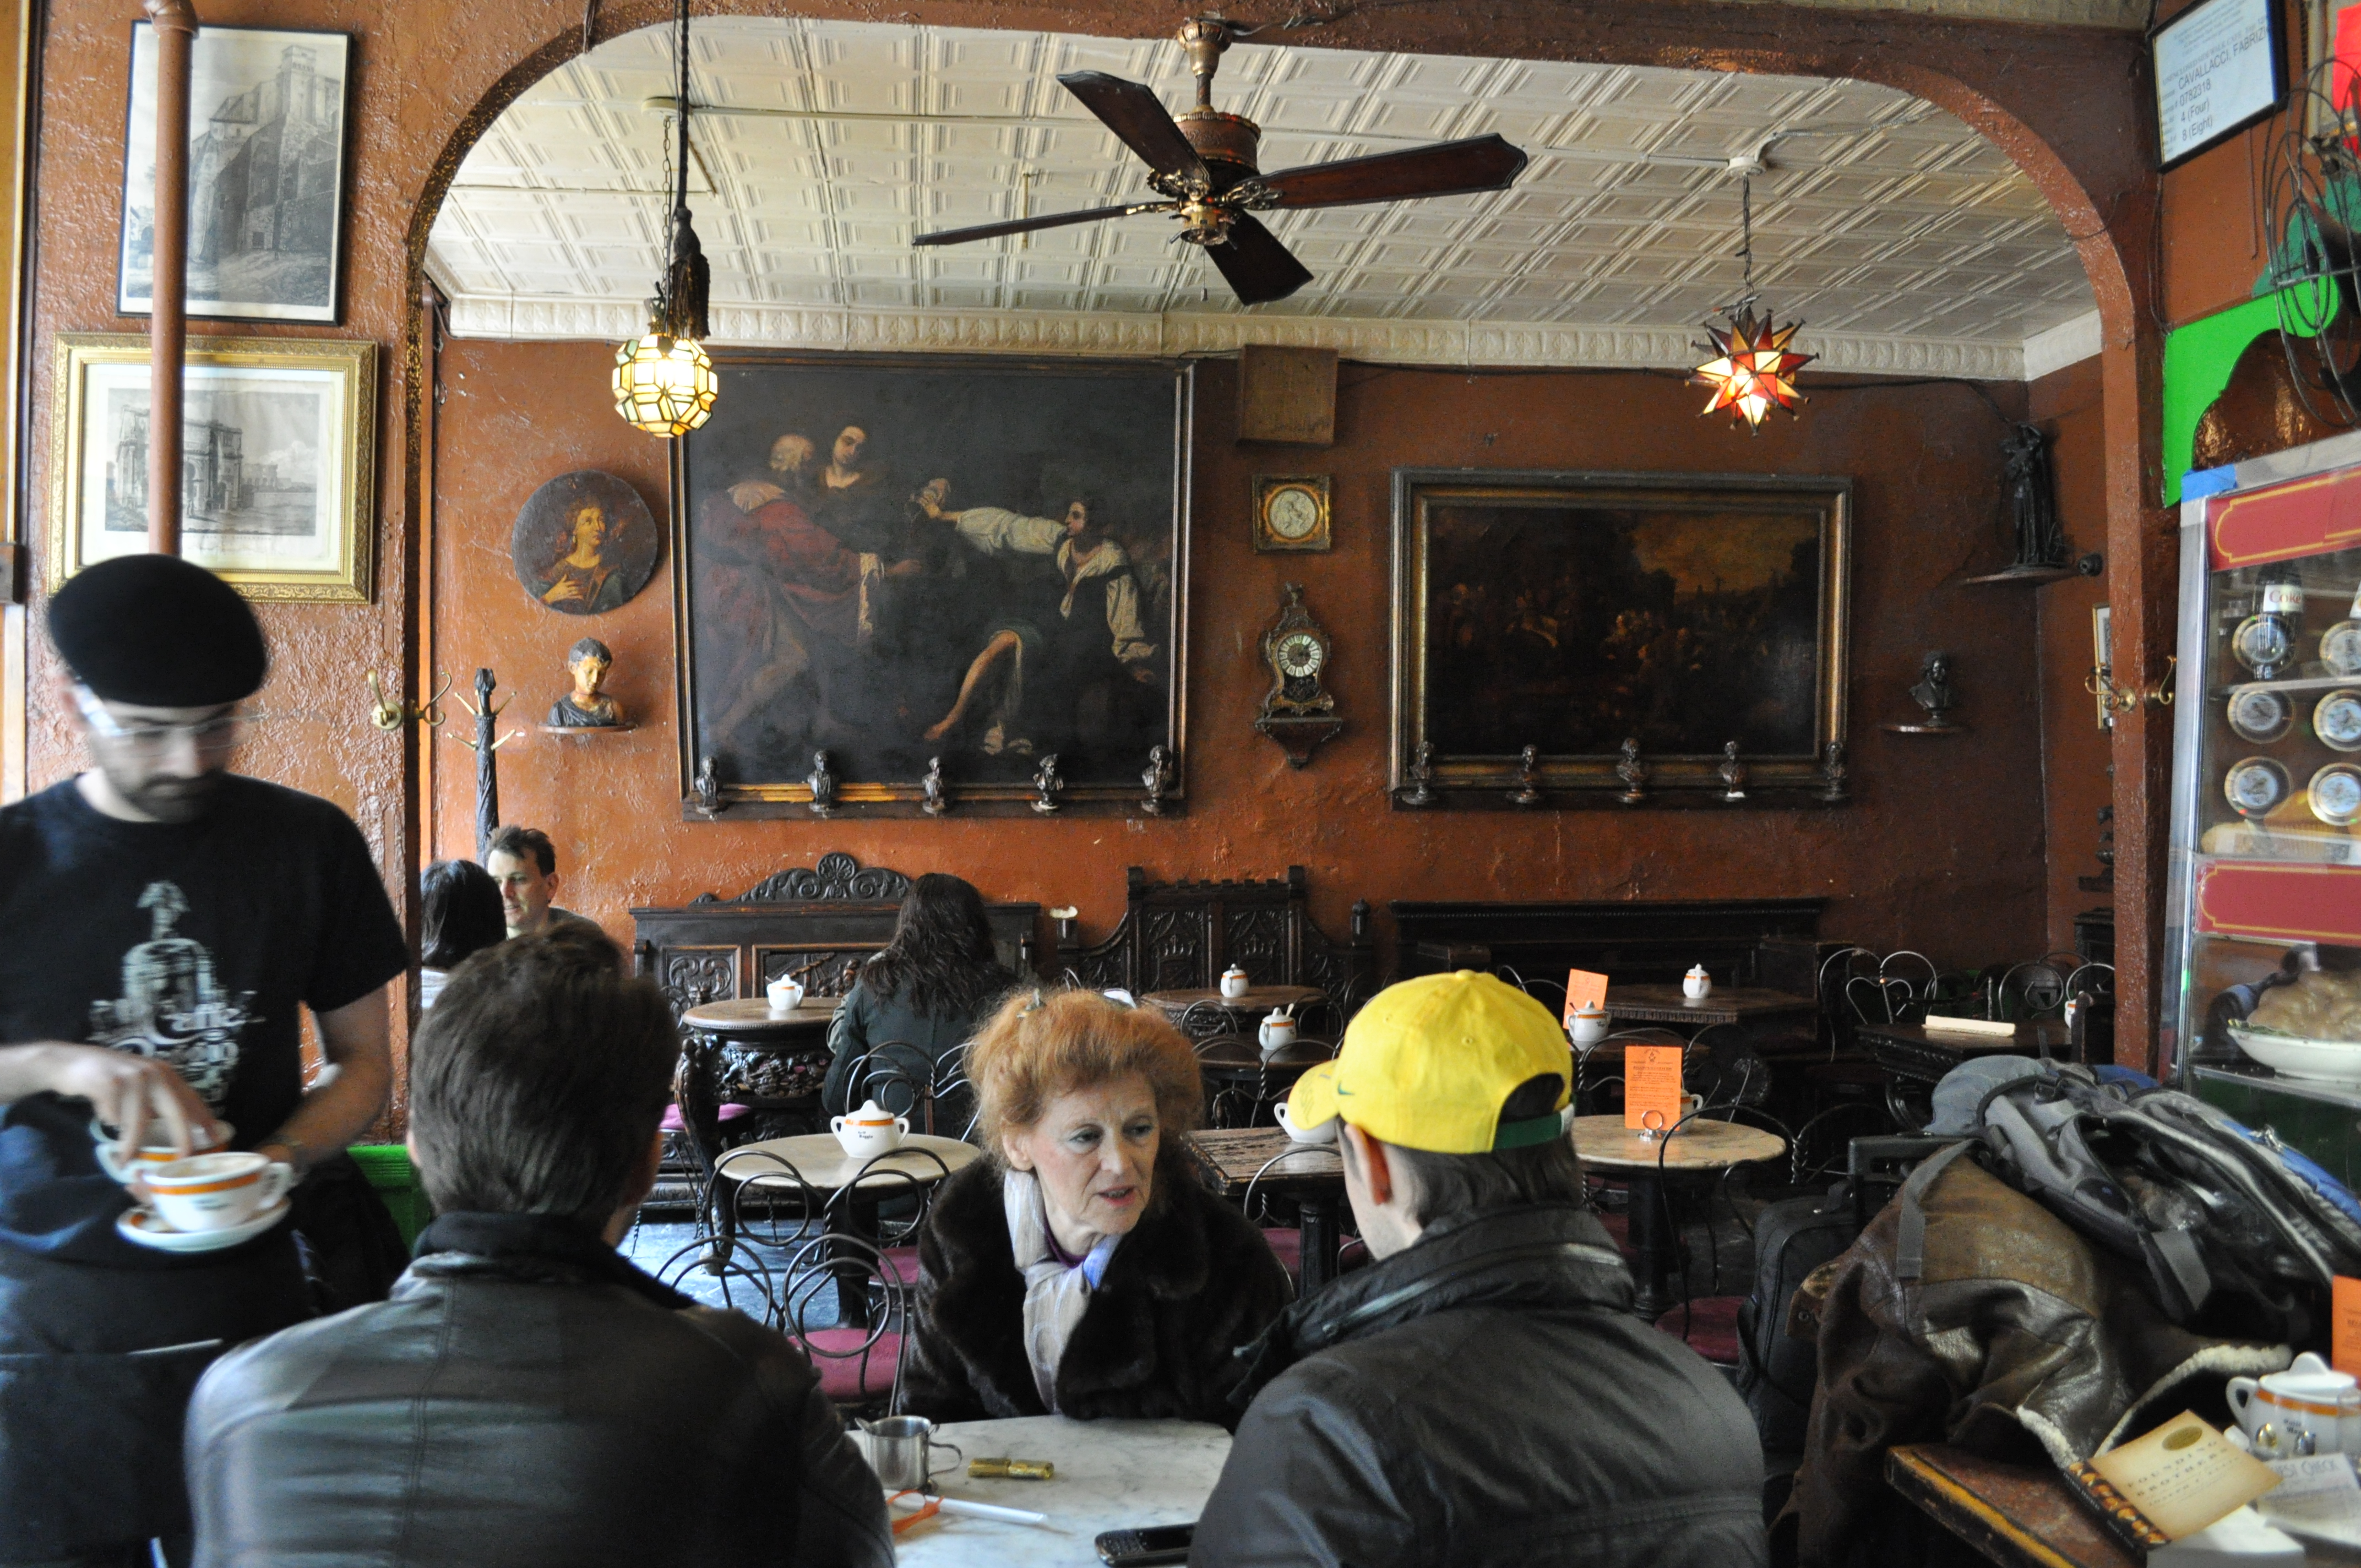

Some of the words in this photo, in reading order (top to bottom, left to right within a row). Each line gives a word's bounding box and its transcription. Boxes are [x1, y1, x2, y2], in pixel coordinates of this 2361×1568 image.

[2233, 26, 2267, 56] FABRIZI
[2179, 78, 2211, 107] 0782318
[2181, 112, 2185, 123] 4
[2187, 98, 2210, 121] (Four)
[2182, 129, 2188, 141] 8
[2189, 117, 2213, 141] (Eight)
[2269, 590, 2301, 603] Coke
